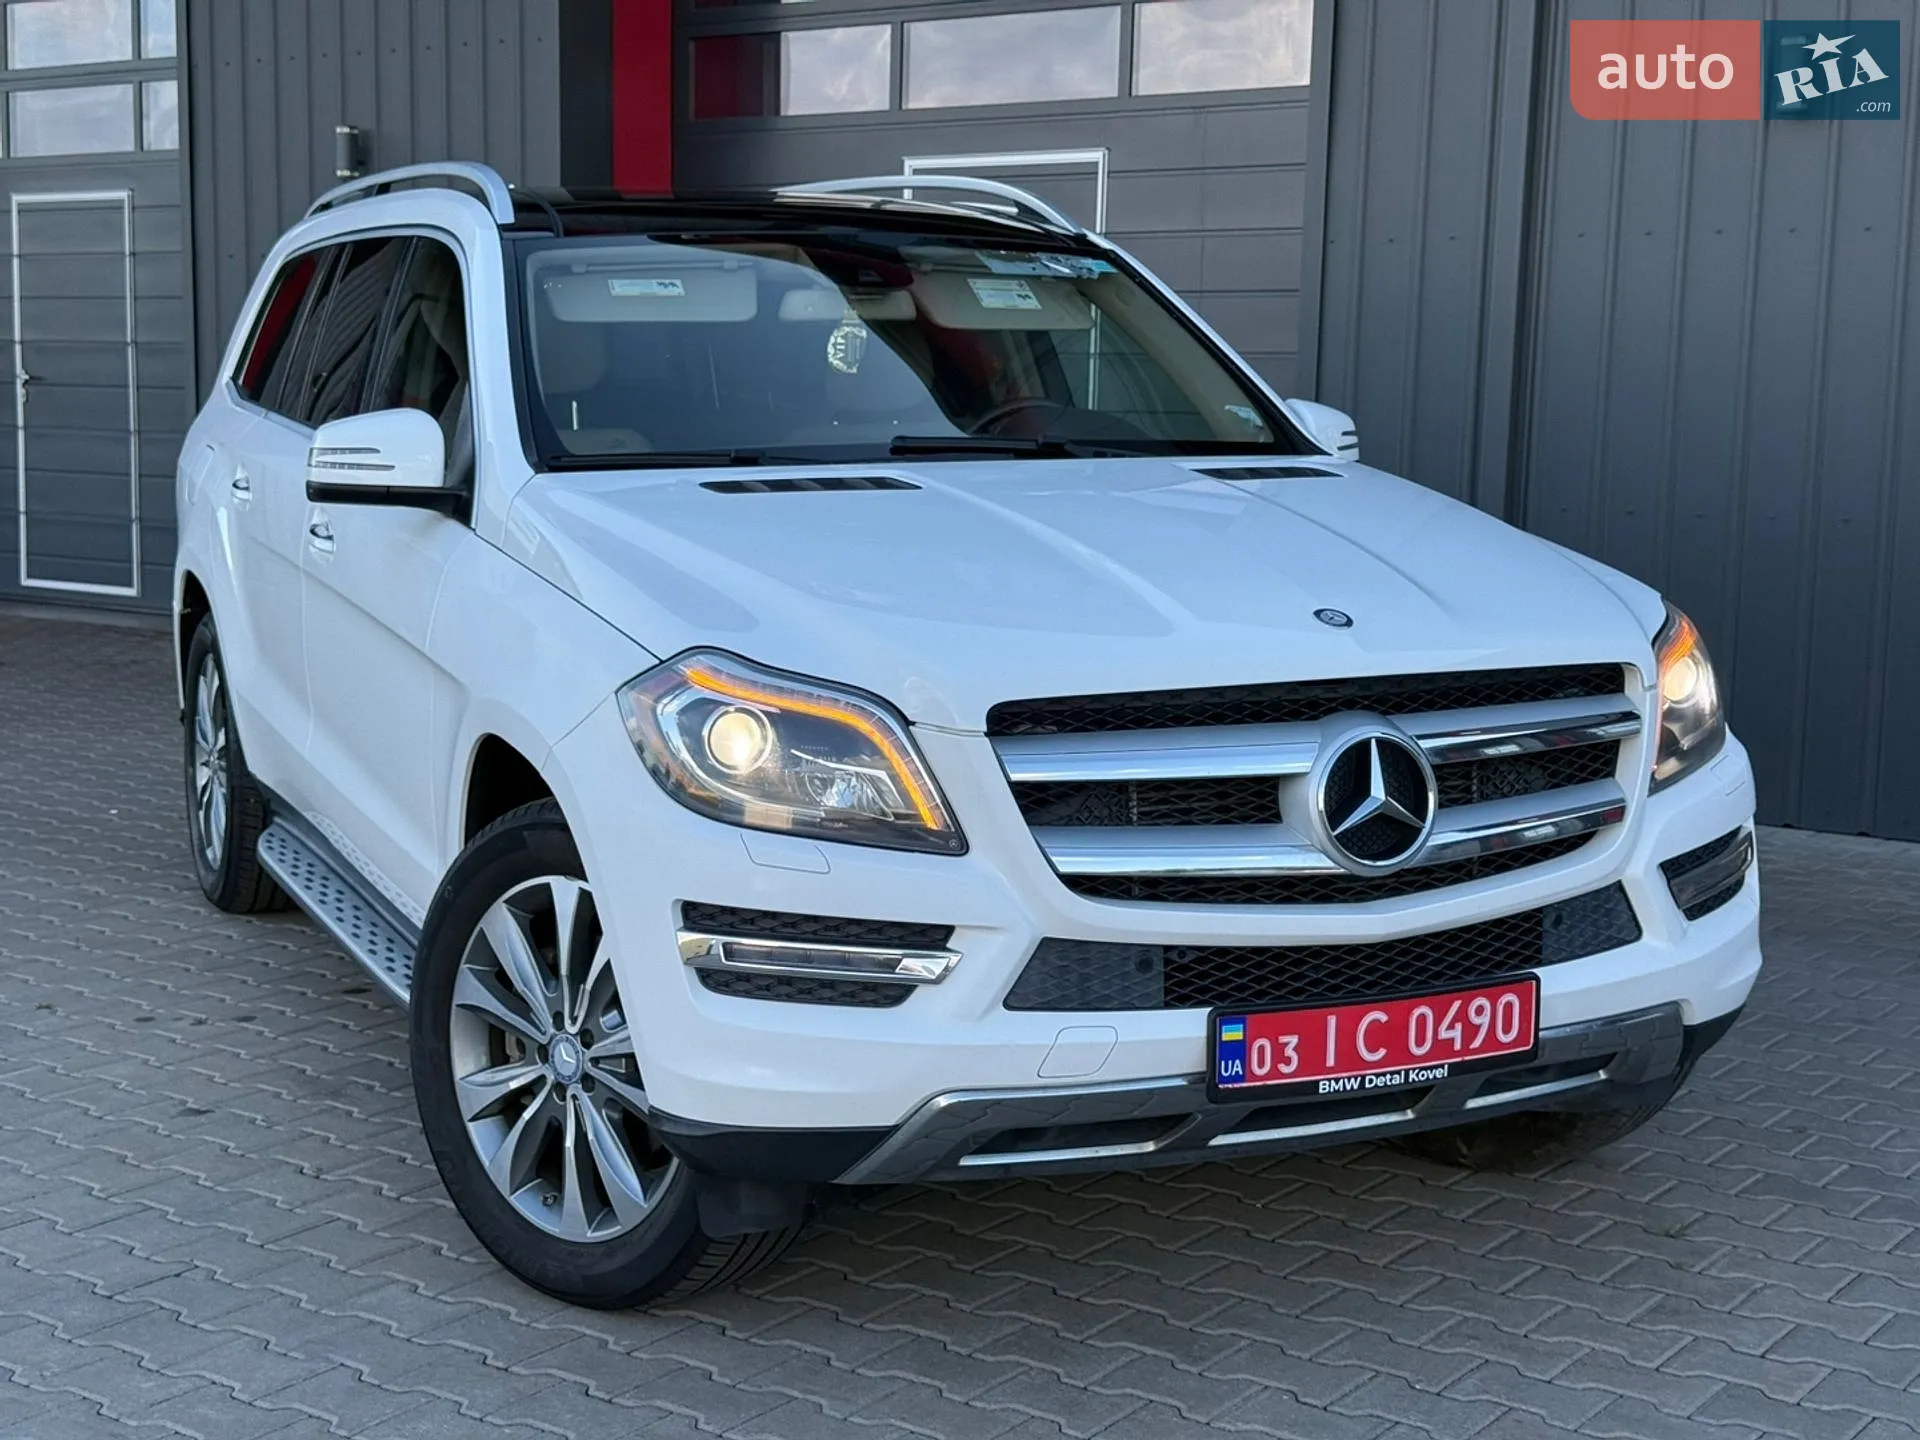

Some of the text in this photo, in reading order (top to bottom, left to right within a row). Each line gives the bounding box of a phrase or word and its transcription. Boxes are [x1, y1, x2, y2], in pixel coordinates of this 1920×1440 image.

[1250, 1034, 1299, 1077] 03
[1408, 992, 1520, 1056] 0490
[1221, 1059, 1243, 1077] UA
[1318, 1064, 1449, 1094] BMW Detal Kovel
